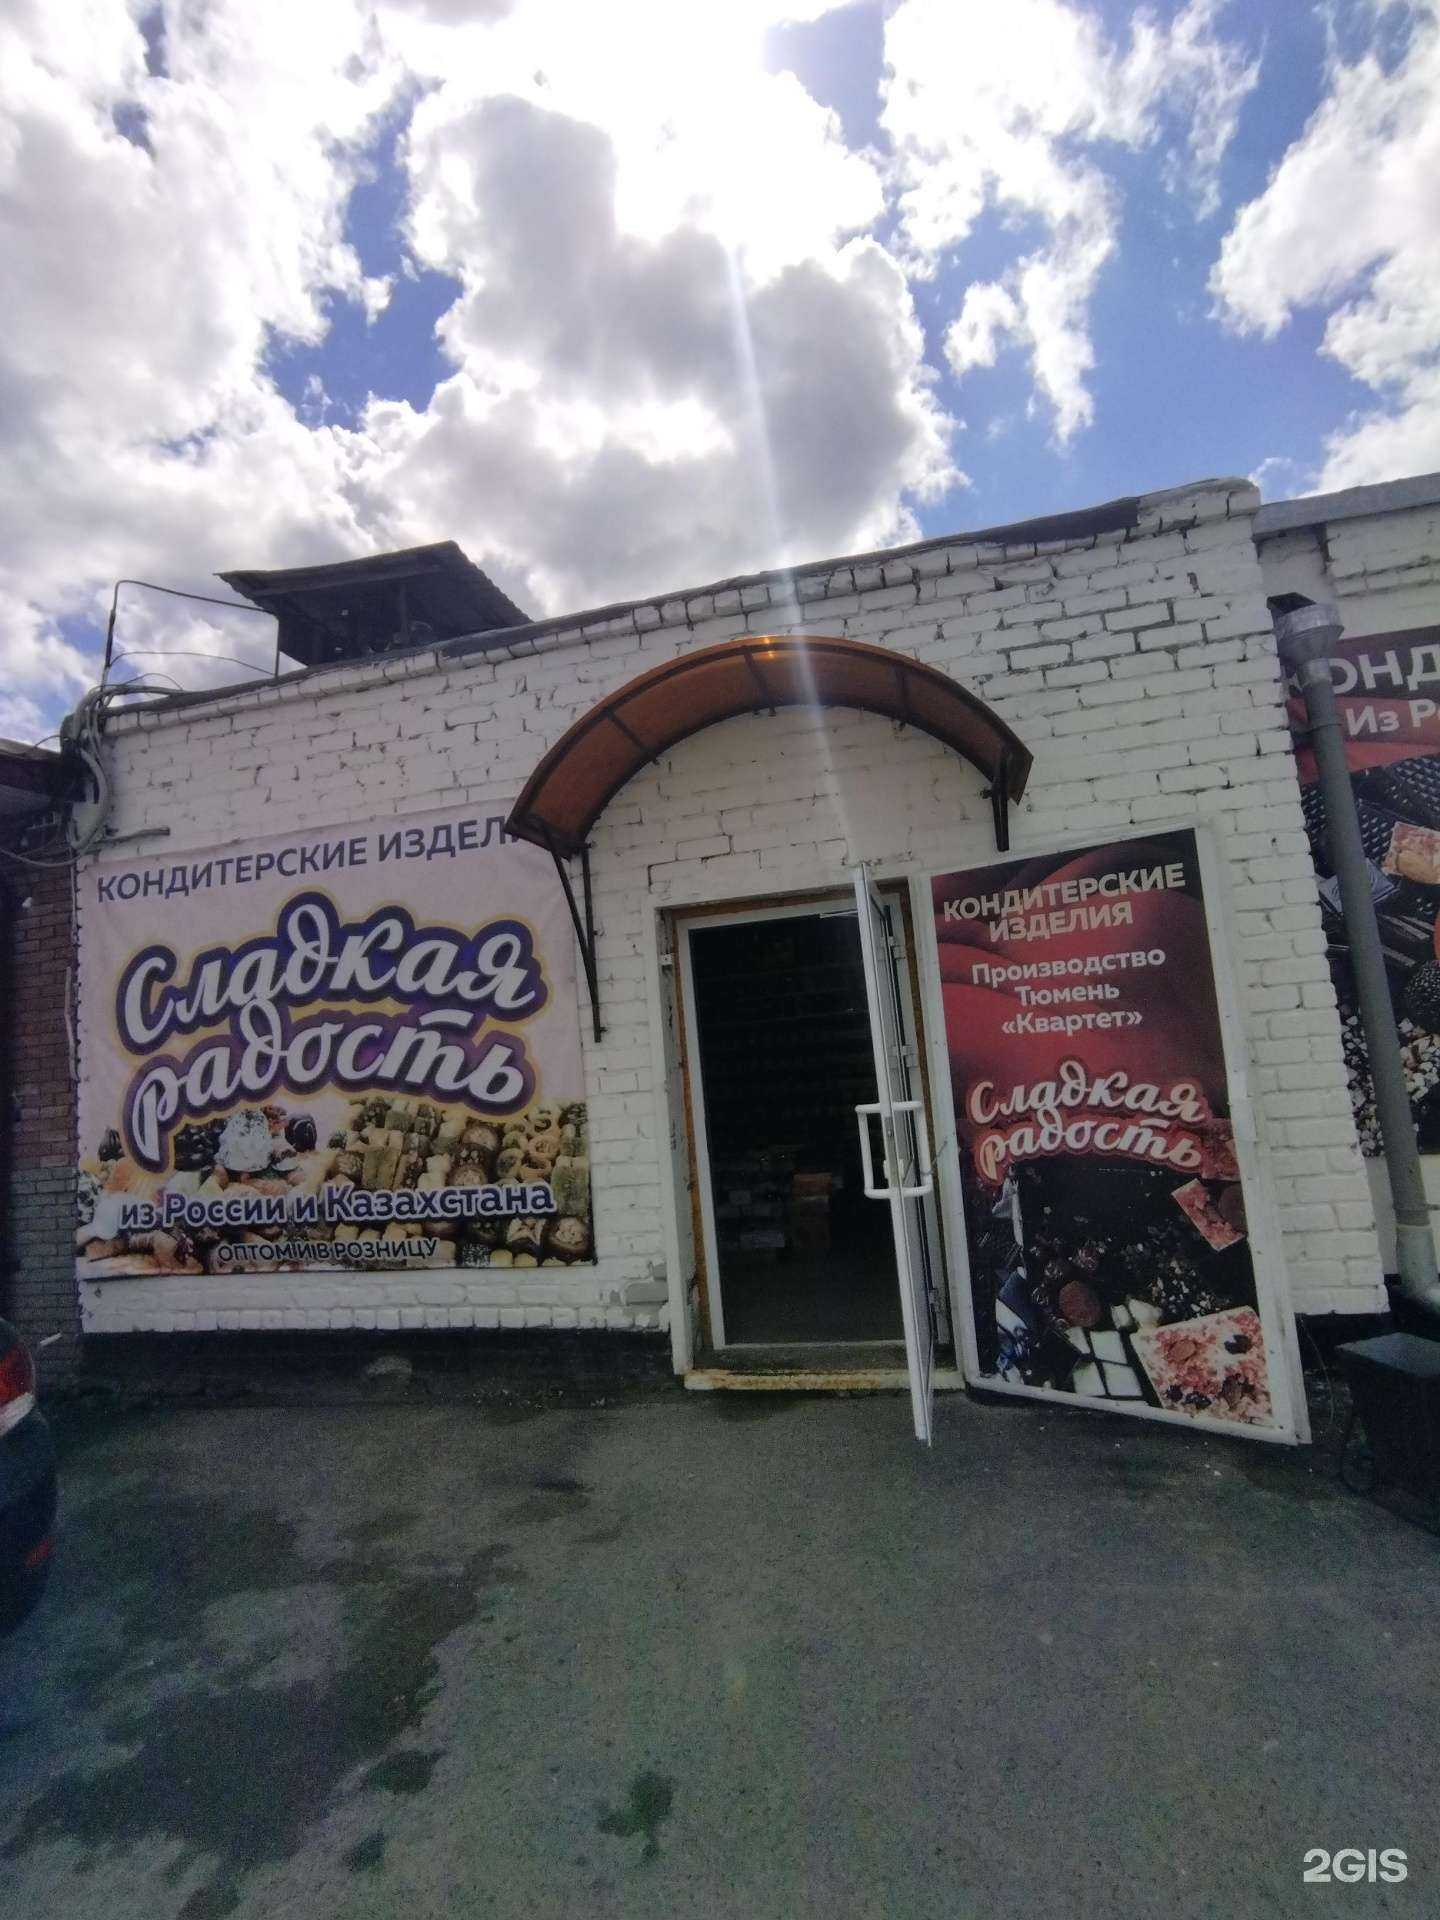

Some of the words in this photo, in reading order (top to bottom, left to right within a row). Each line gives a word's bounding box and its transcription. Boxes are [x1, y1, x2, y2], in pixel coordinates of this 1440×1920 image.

[1294, 643, 1440, 694] ОНД
[1344, 704, 1401, 737] Из
[1407, 697, 1440, 729] Р
[96, 835, 368, 904] КОНДИТЕРСКИЕ
[377, 814, 520, 862] ИЗДЕЛ
[943, 862, 1186, 922] КОНДИТЕРСКИЕ
[989, 901, 1134, 943] ИЗДЕЛИЯ
[121, 900, 539, 1047] Сладкая
[971, 948, 1167, 989] Производство
[1014, 981, 1121, 1007] Тюмень
[1001, 1008, 1143, 1037] «Квартет»
[129, 1000, 526, 1163] радость
[970, 1058, 1205, 1124] Сладкая
[979, 1108, 1202, 1181] радость
[121, 1201, 155, 1227] из
[163, 1192, 286, 1228] России
[294, 1195, 318, 1223] и
[324, 1184, 556, 1221] Казахстана
[218, 1244, 294, 1262] ОПТОМ
[334, 1239, 437, 1259] РОЗНИЦУ
